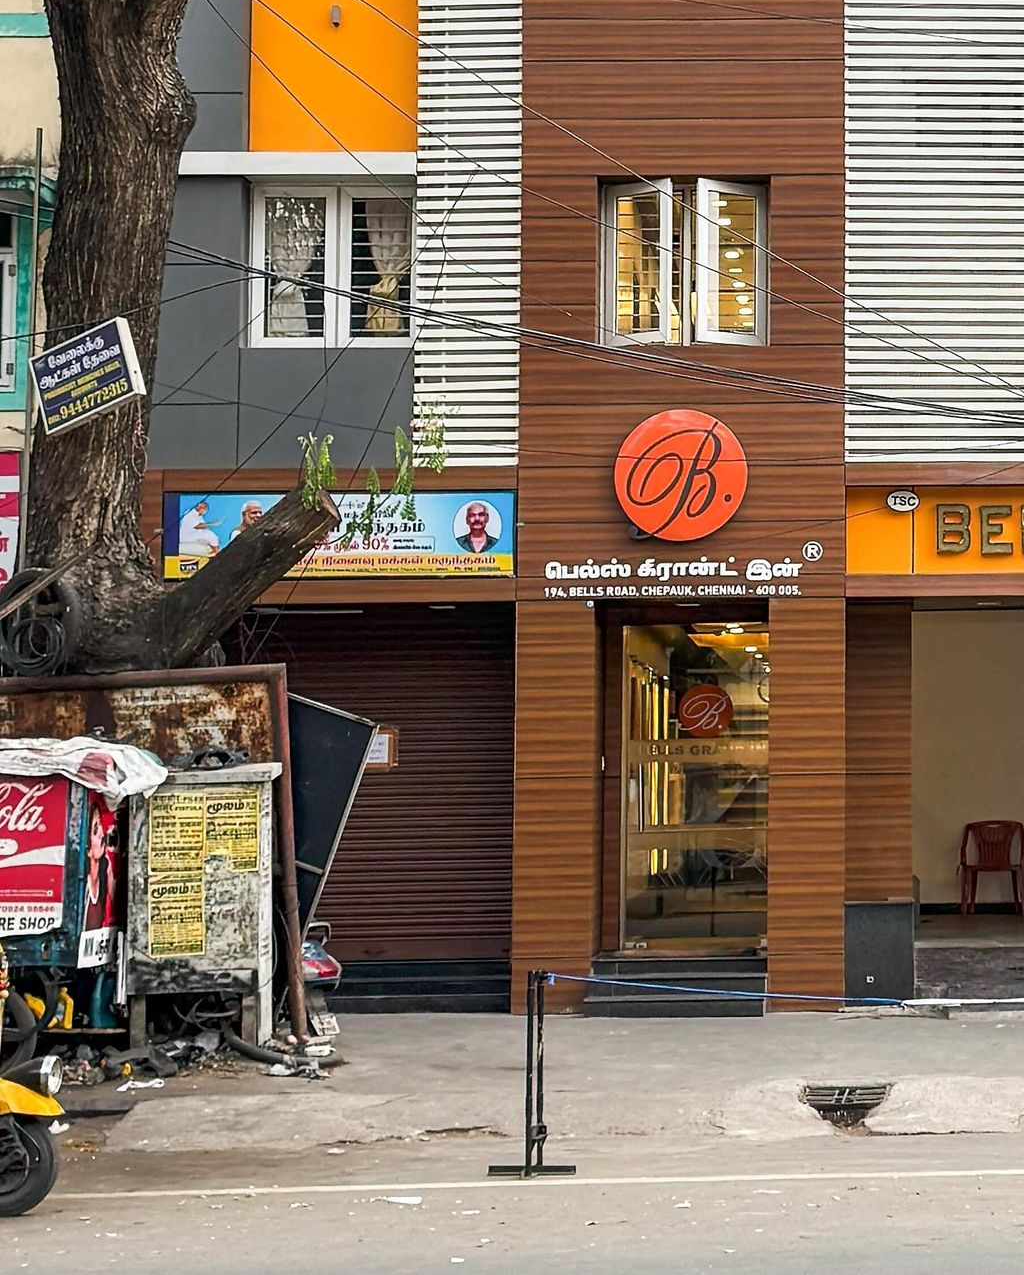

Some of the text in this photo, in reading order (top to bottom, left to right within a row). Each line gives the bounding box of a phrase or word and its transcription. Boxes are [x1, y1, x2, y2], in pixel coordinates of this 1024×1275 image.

[39, 359, 82, 390] ஆட்கள்
[82, 344, 121, 372] தேவை
[60, 378, 129, 420] 9444772315
[545, 558, 632, 579] பெல்ஸ்
[746, 557, 803, 581] இன்
[544, 587, 567, 598] 194,
[569, 586, 604, 597] BELLS
[606, 585, 639, 597] ROAD,
[641, 585, 696, 597] CHEPAUK,
[697, 585, 746, 597] CHENNAI
[755, 585, 776, 596] 600
[207, 798, 245, 814] மூலம்
[151, 882, 189, 899] மூலம்
[19, 917, 55, 930] SHOP
